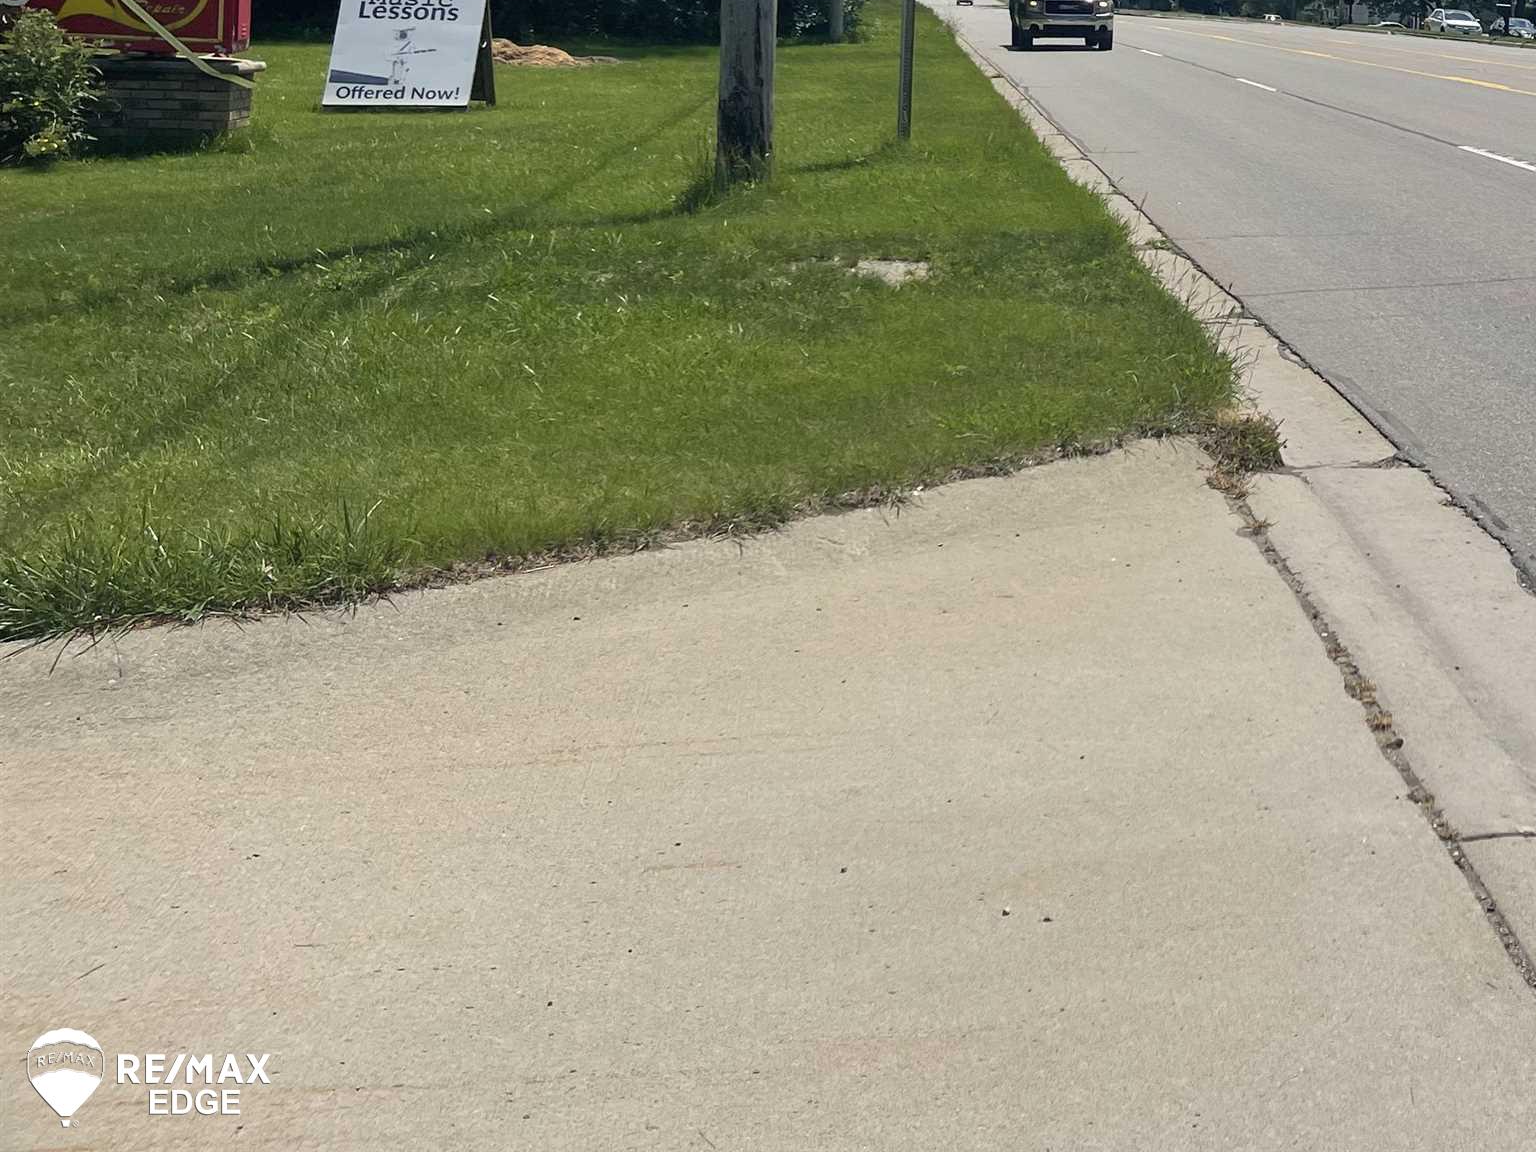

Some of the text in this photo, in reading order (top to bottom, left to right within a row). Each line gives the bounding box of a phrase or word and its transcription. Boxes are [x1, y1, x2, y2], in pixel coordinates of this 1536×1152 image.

[358, 1, 459, 21] Lessons
[335, 86, 460, 100] Offered Now!
